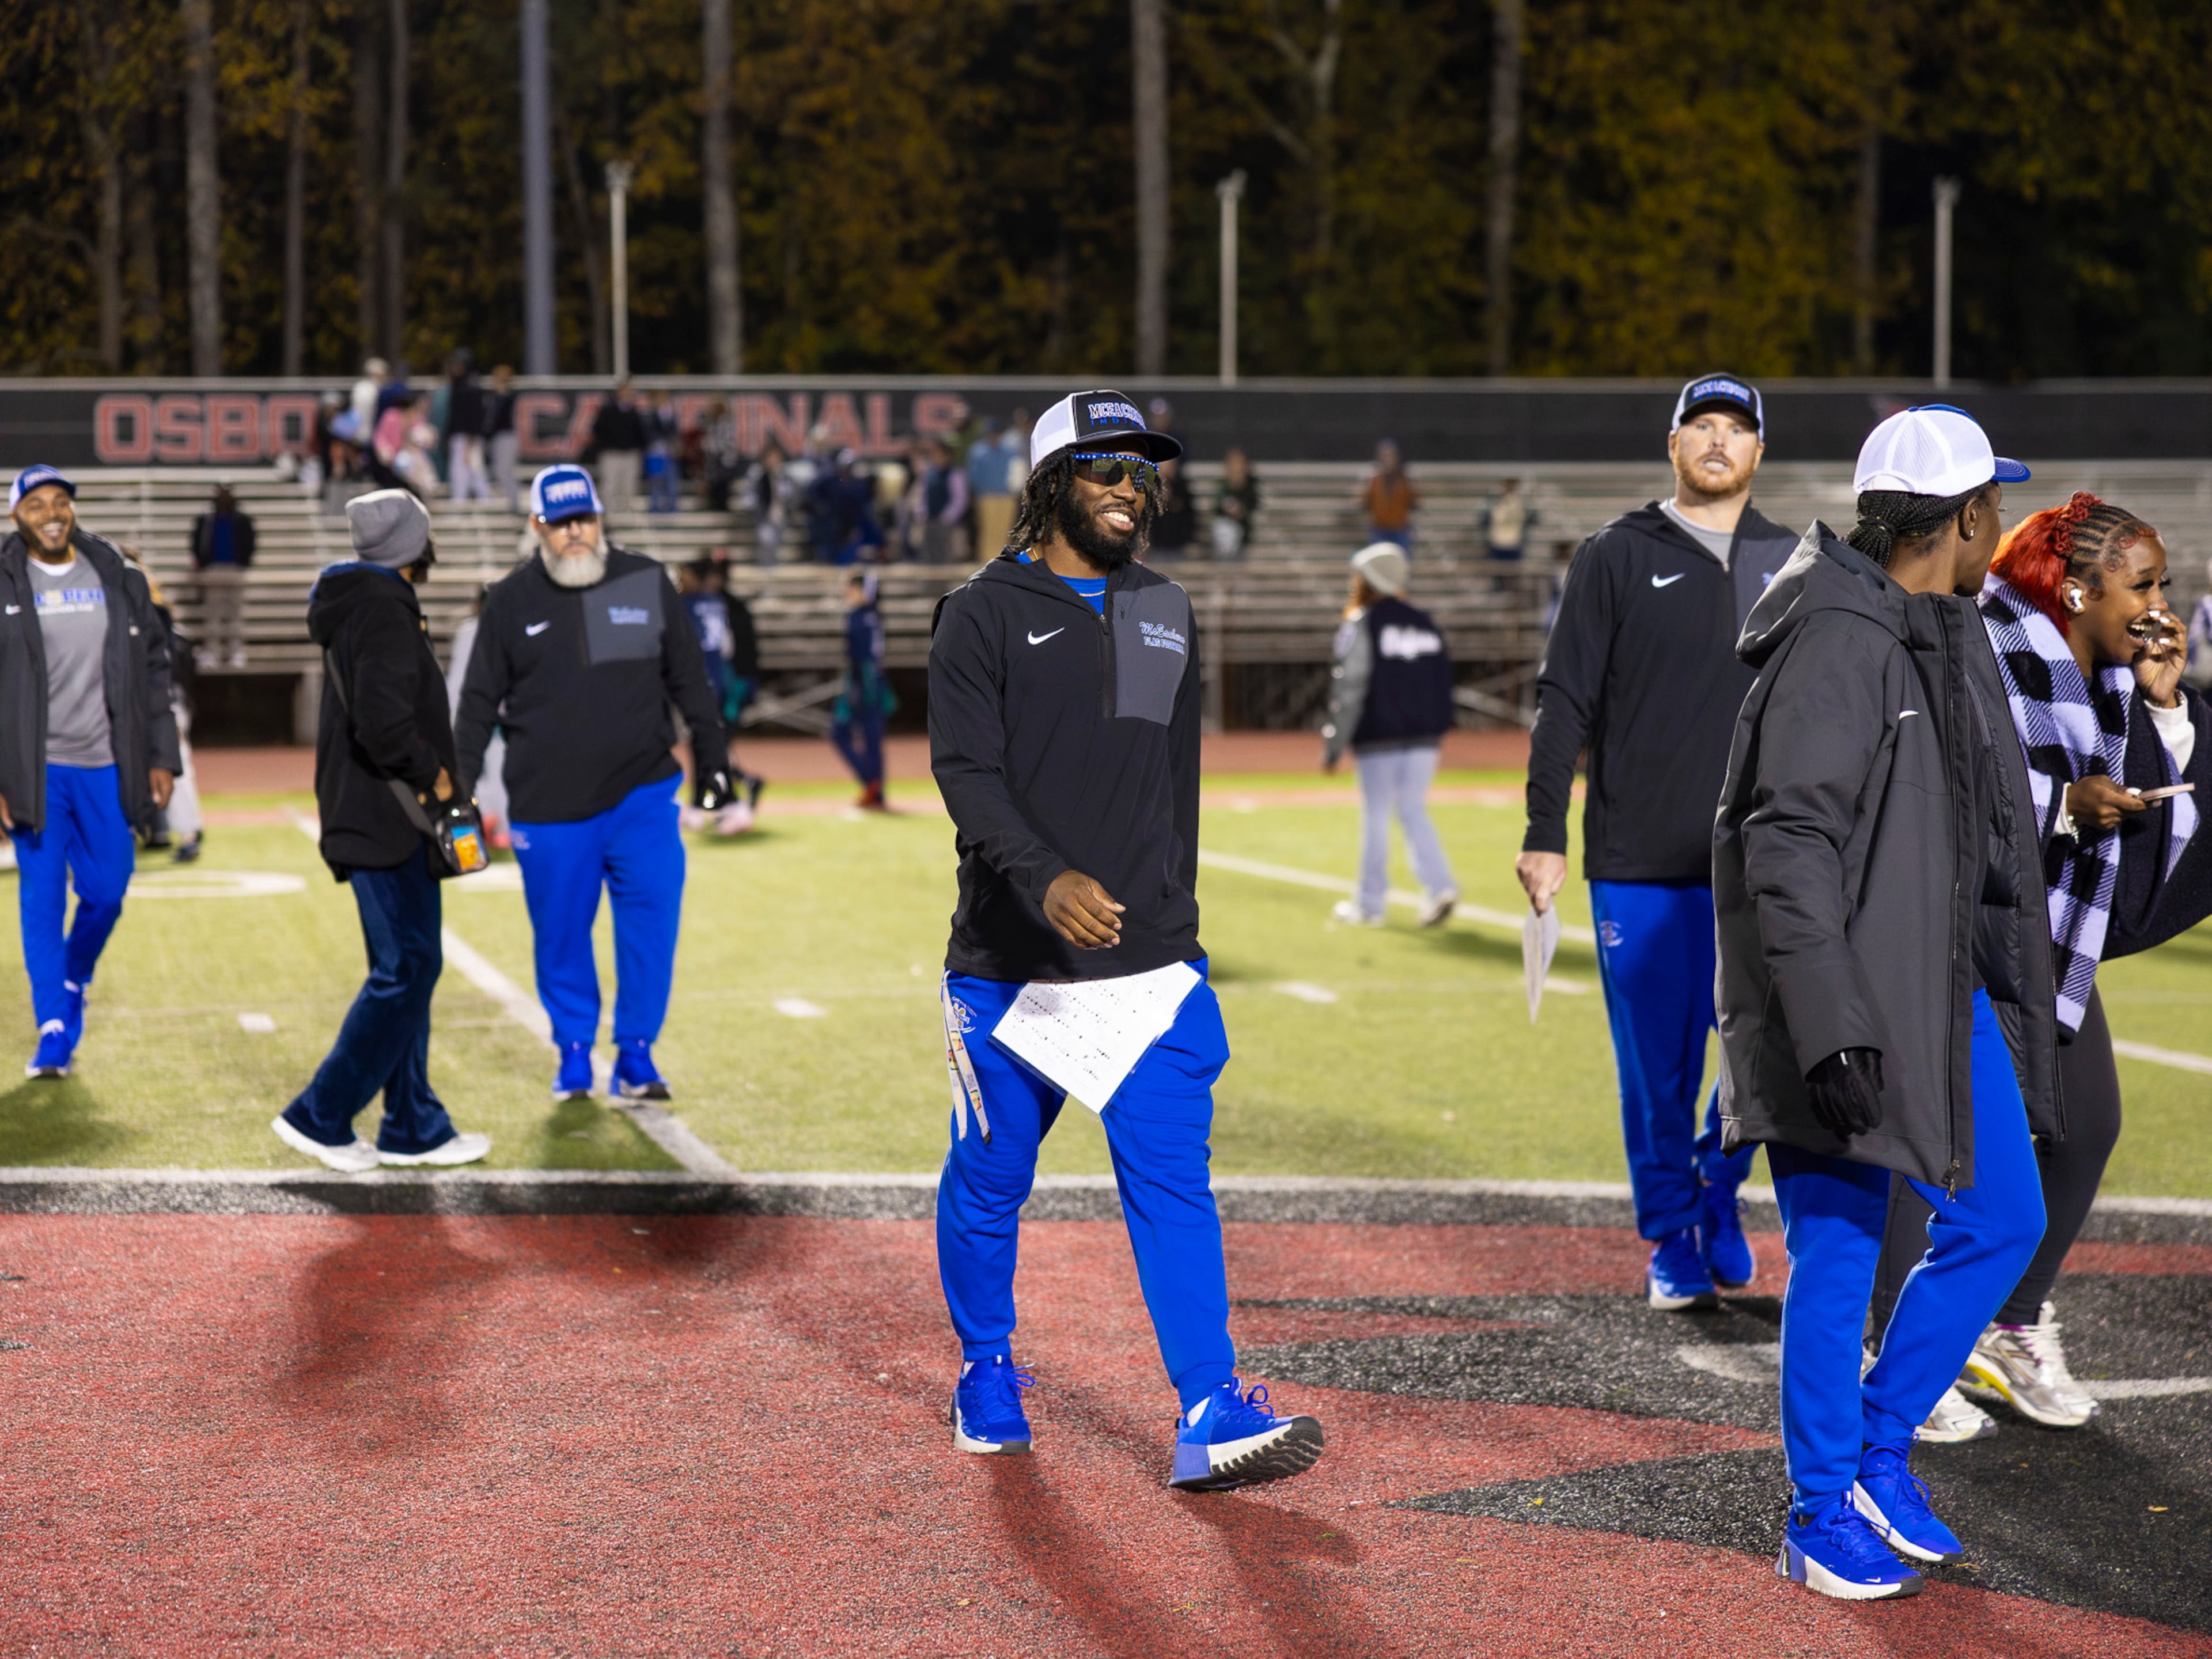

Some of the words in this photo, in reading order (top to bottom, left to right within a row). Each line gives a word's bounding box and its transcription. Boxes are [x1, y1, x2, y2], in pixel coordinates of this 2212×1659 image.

[94, 394, 320, 461] OSBO
[513, 393, 970, 457] CAINALS
[1088, 403, 1146, 431] MCEAC
